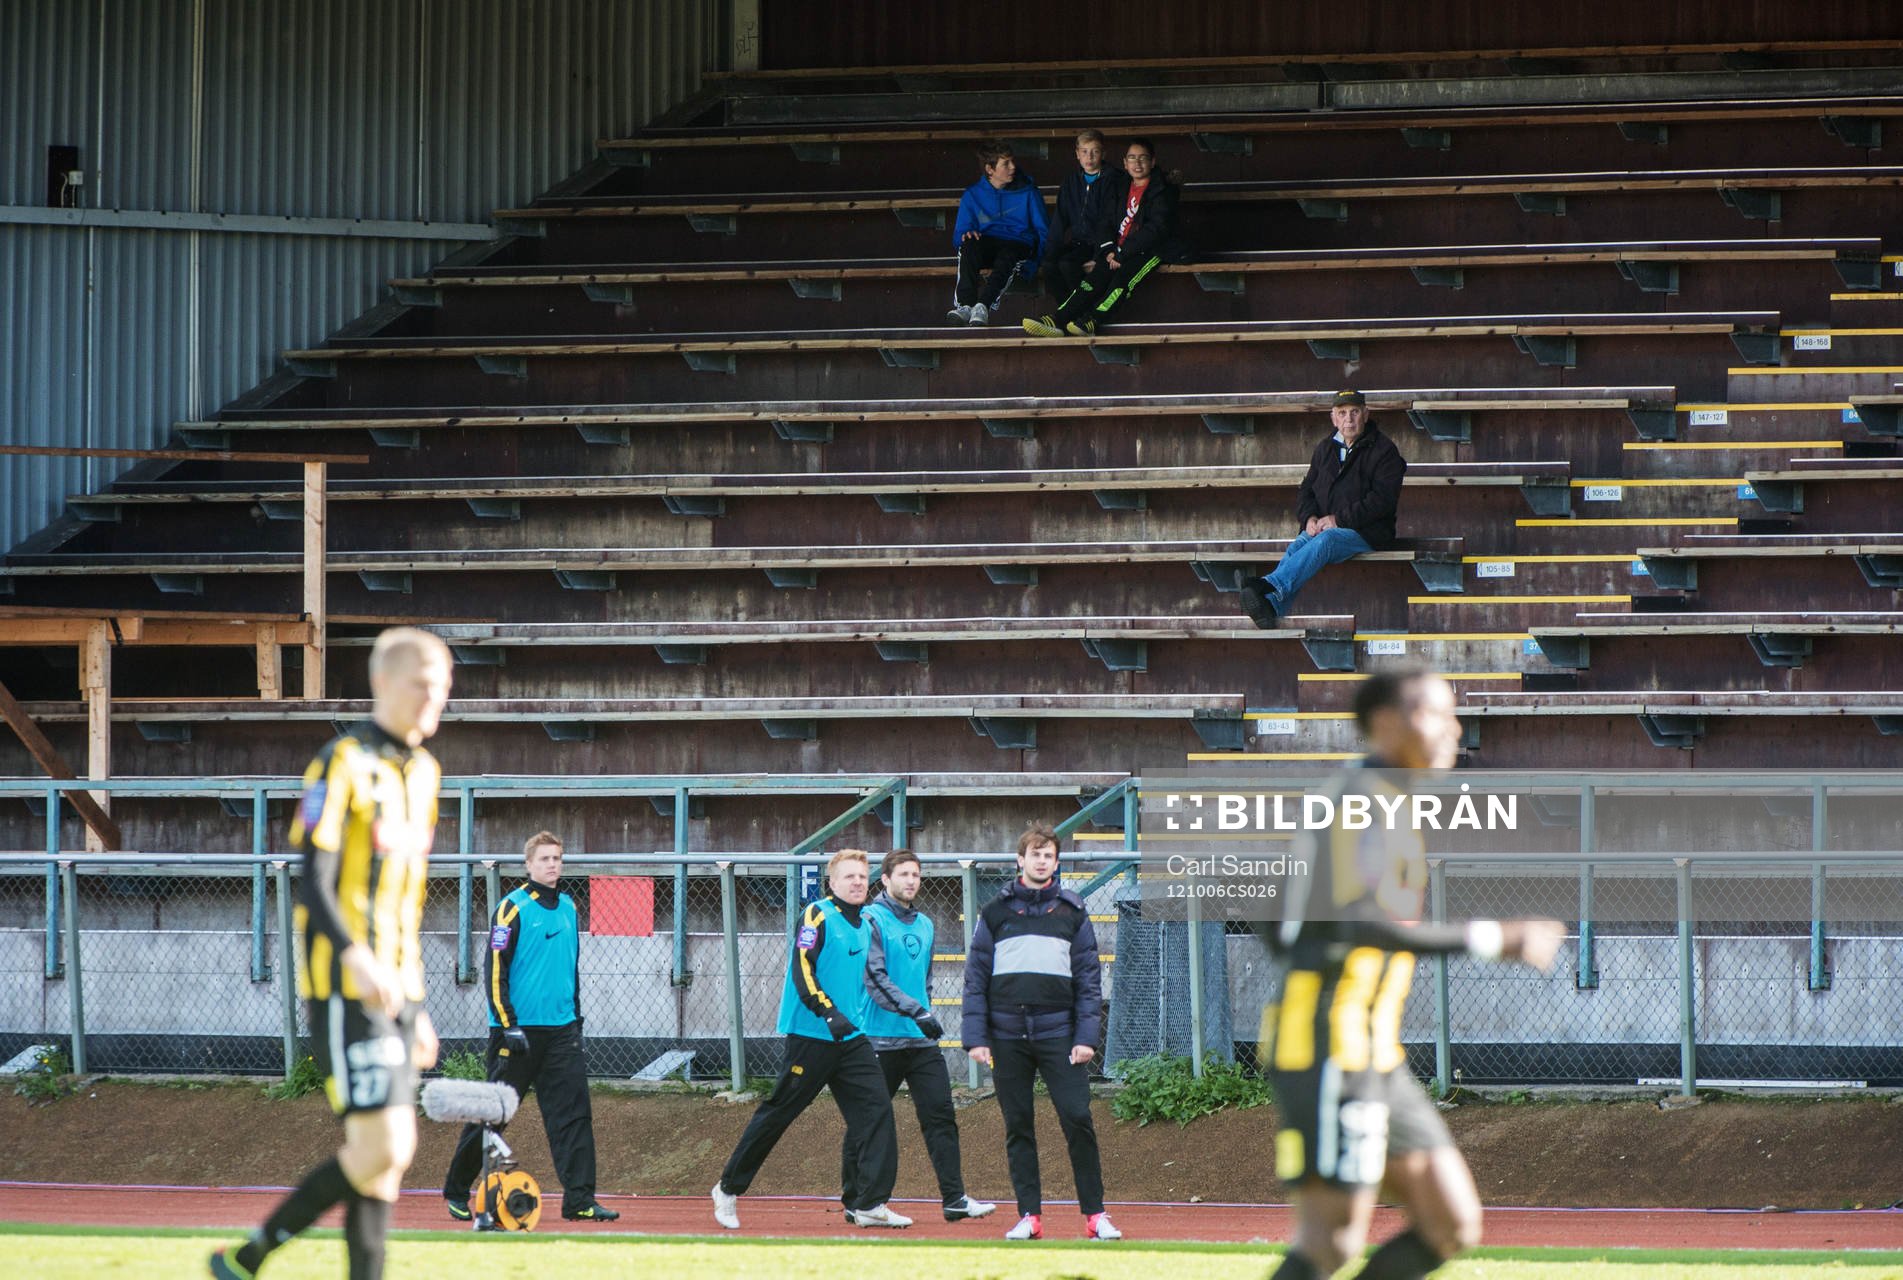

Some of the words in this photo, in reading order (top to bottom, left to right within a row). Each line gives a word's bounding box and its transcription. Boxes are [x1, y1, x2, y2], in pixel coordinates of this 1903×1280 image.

[1698, 413, 1724, 421] 147-127
[1592, 489, 1619, 497] 106-126
[1486, 565, 1511, 573] 105-85
[801, 865, 818, 898] F
